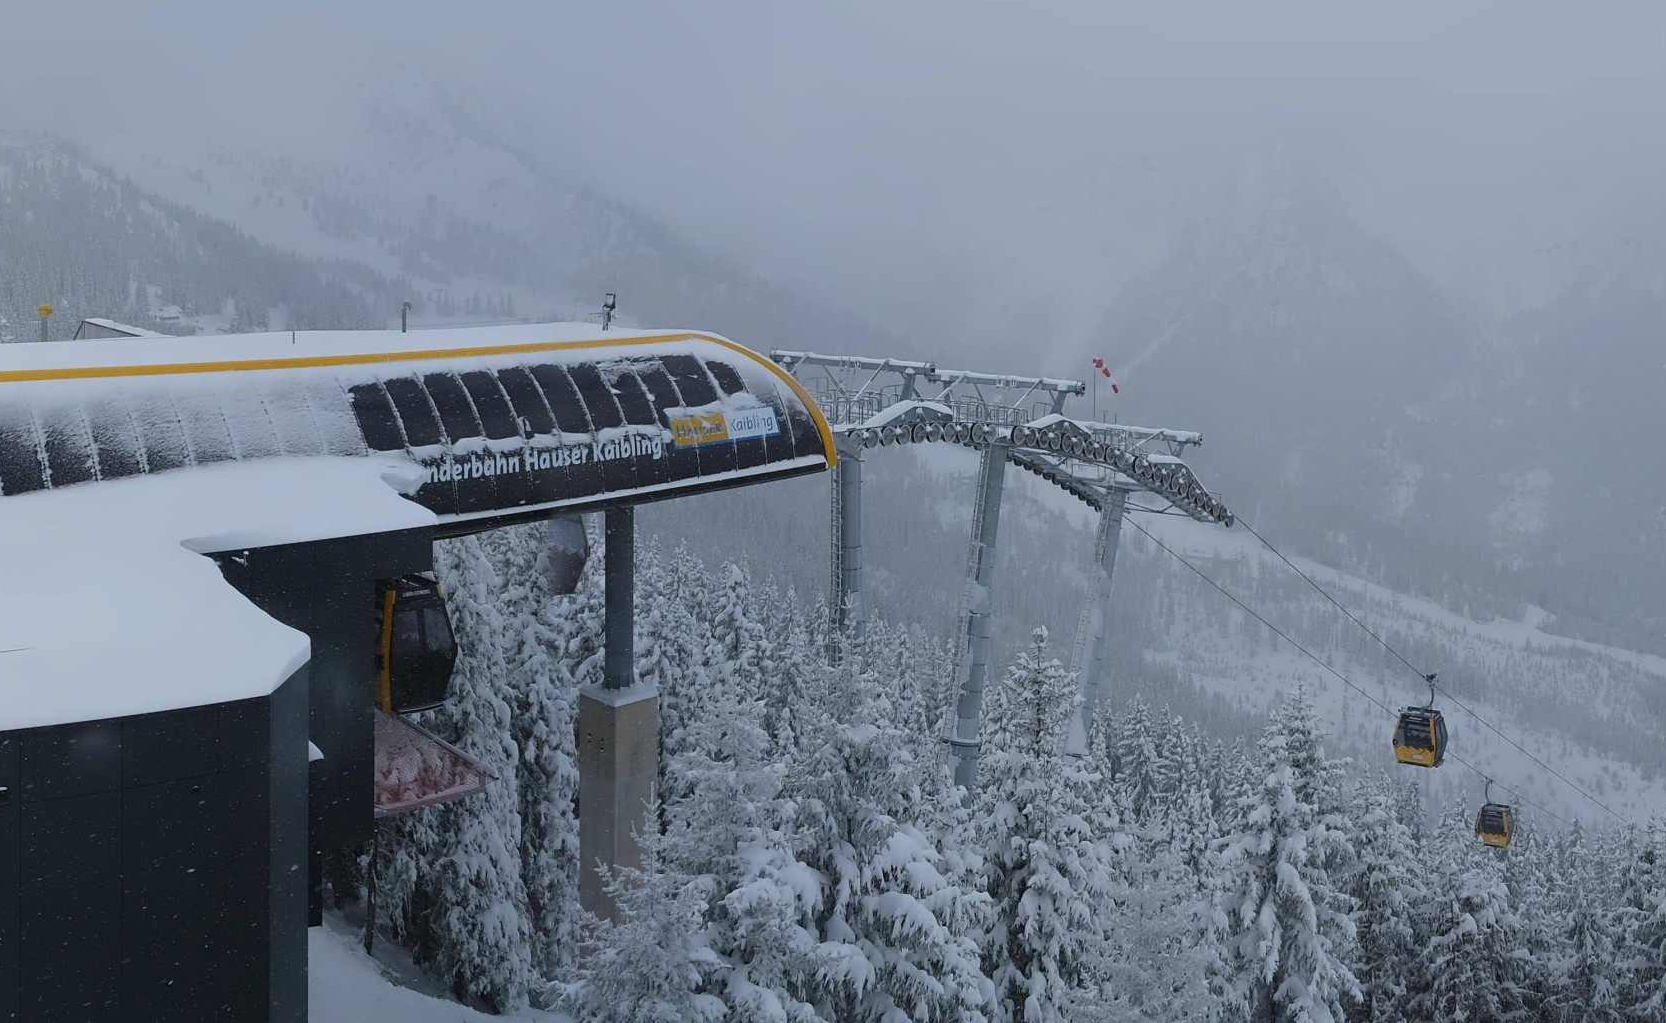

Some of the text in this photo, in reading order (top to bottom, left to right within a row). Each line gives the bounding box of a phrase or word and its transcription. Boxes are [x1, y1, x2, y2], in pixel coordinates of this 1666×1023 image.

[426, 434, 663, 484] nderbahn Hauser Kaibling
